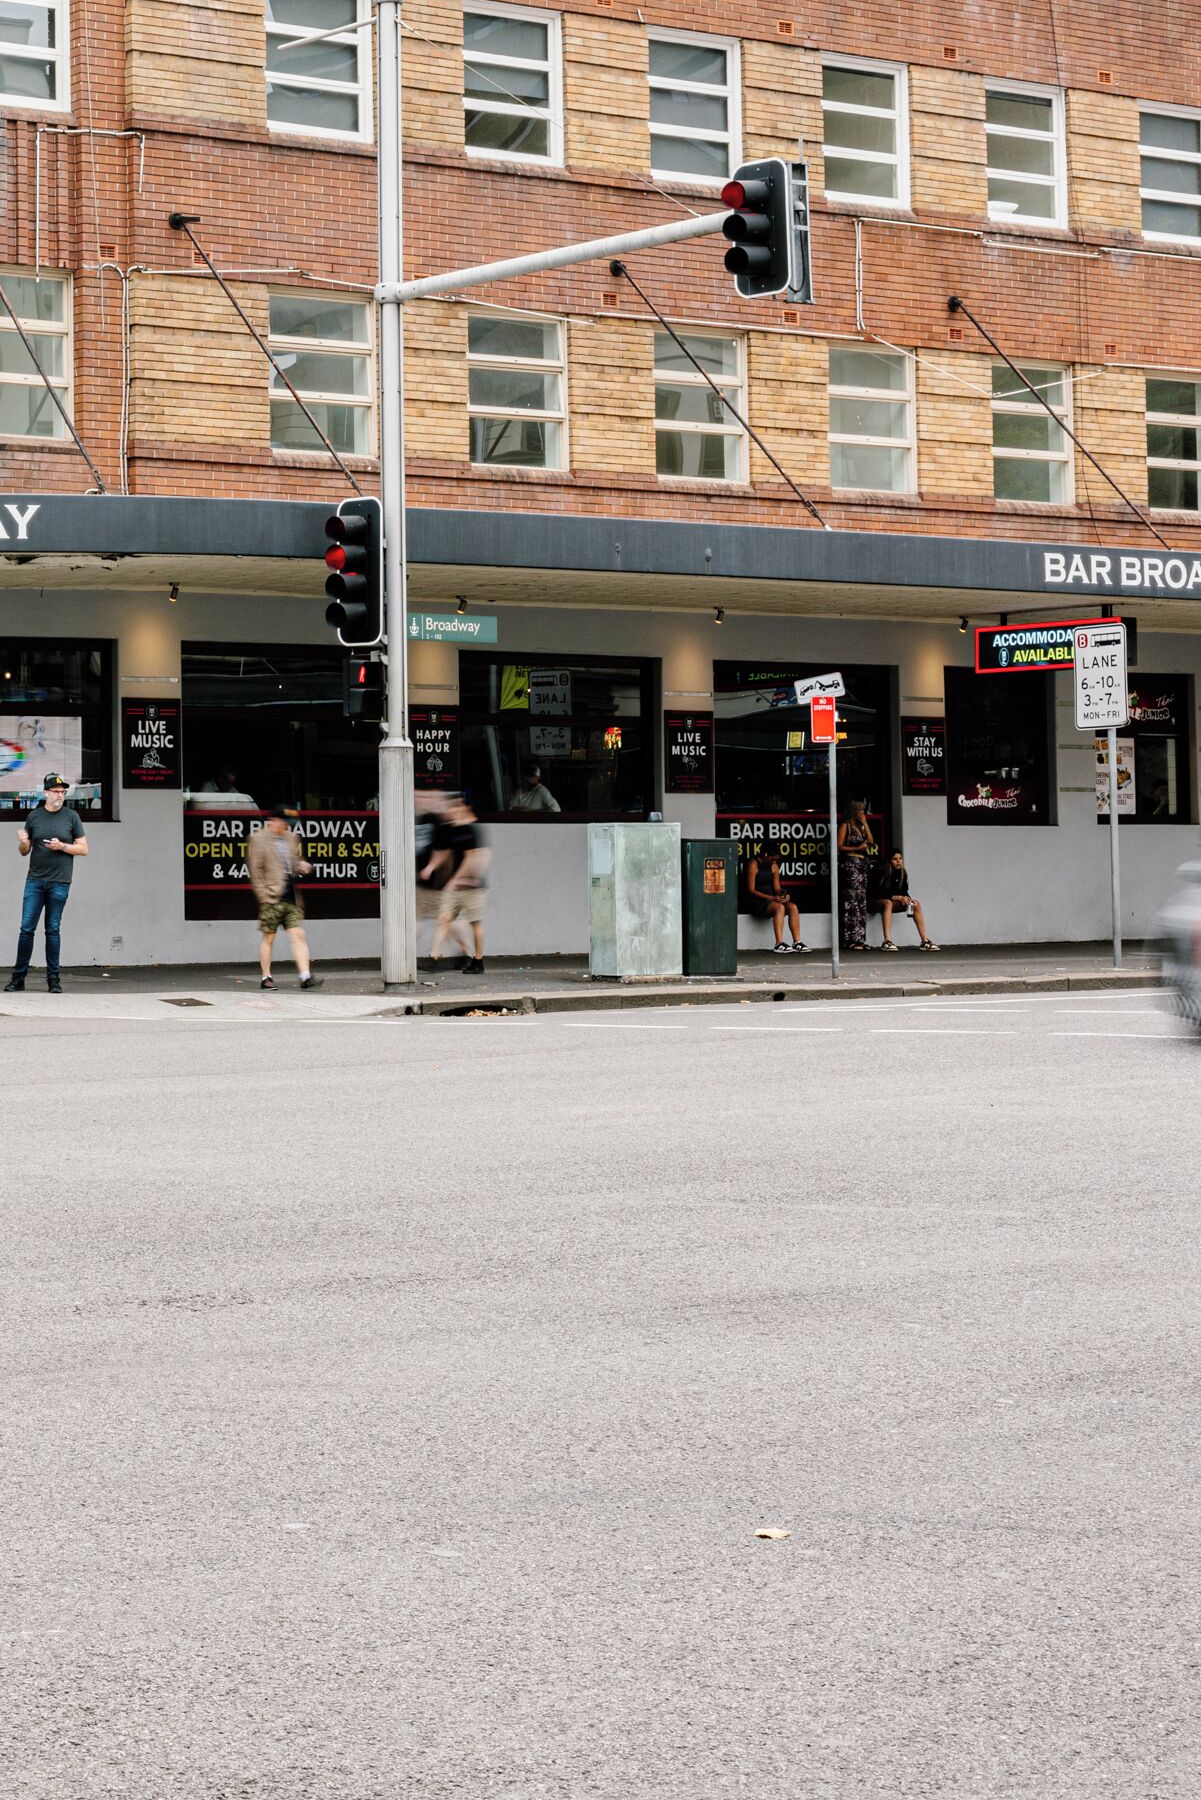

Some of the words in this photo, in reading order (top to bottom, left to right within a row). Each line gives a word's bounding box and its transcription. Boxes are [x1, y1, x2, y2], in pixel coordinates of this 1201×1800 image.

[1044, 552, 1113, 585] BAR
[425, 617, 481, 636] Broadway
[993, 629, 1074, 647] ACCOMMODA
[1082, 654, 1118, 669] LANE
[1141, 707, 1171, 721] JUNIOR
[138, 720, 166, 734] LIVE
[131, 734, 174, 748] MUSIC
[416, 729, 451, 740] HAPPY
[677, 732, 701, 743] LIVE
[416, 743, 450, 753] HOUR
[913, 737, 936, 747] STAY
[671, 745, 707, 756] MUSIC
[907, 747, 930, 757] WITH
[931, 747, 943, 757] US
[202, 820, 244, 838] BAR
[250, 820, 367, 838] BADWAY
[730, 823, 764, 839] BAR
[769, 823, 837, 839] BROAD
[185, 843, 233, 858] OPEN
[308, 843, 332, 858] FRI
[337, 843, 348, 858] &
[352, 842, 380, 858] SAT
[212, 864, 224, 879] &
[228, 863, 251, 879] 4A
[314, 863, 358, 878] THUR
